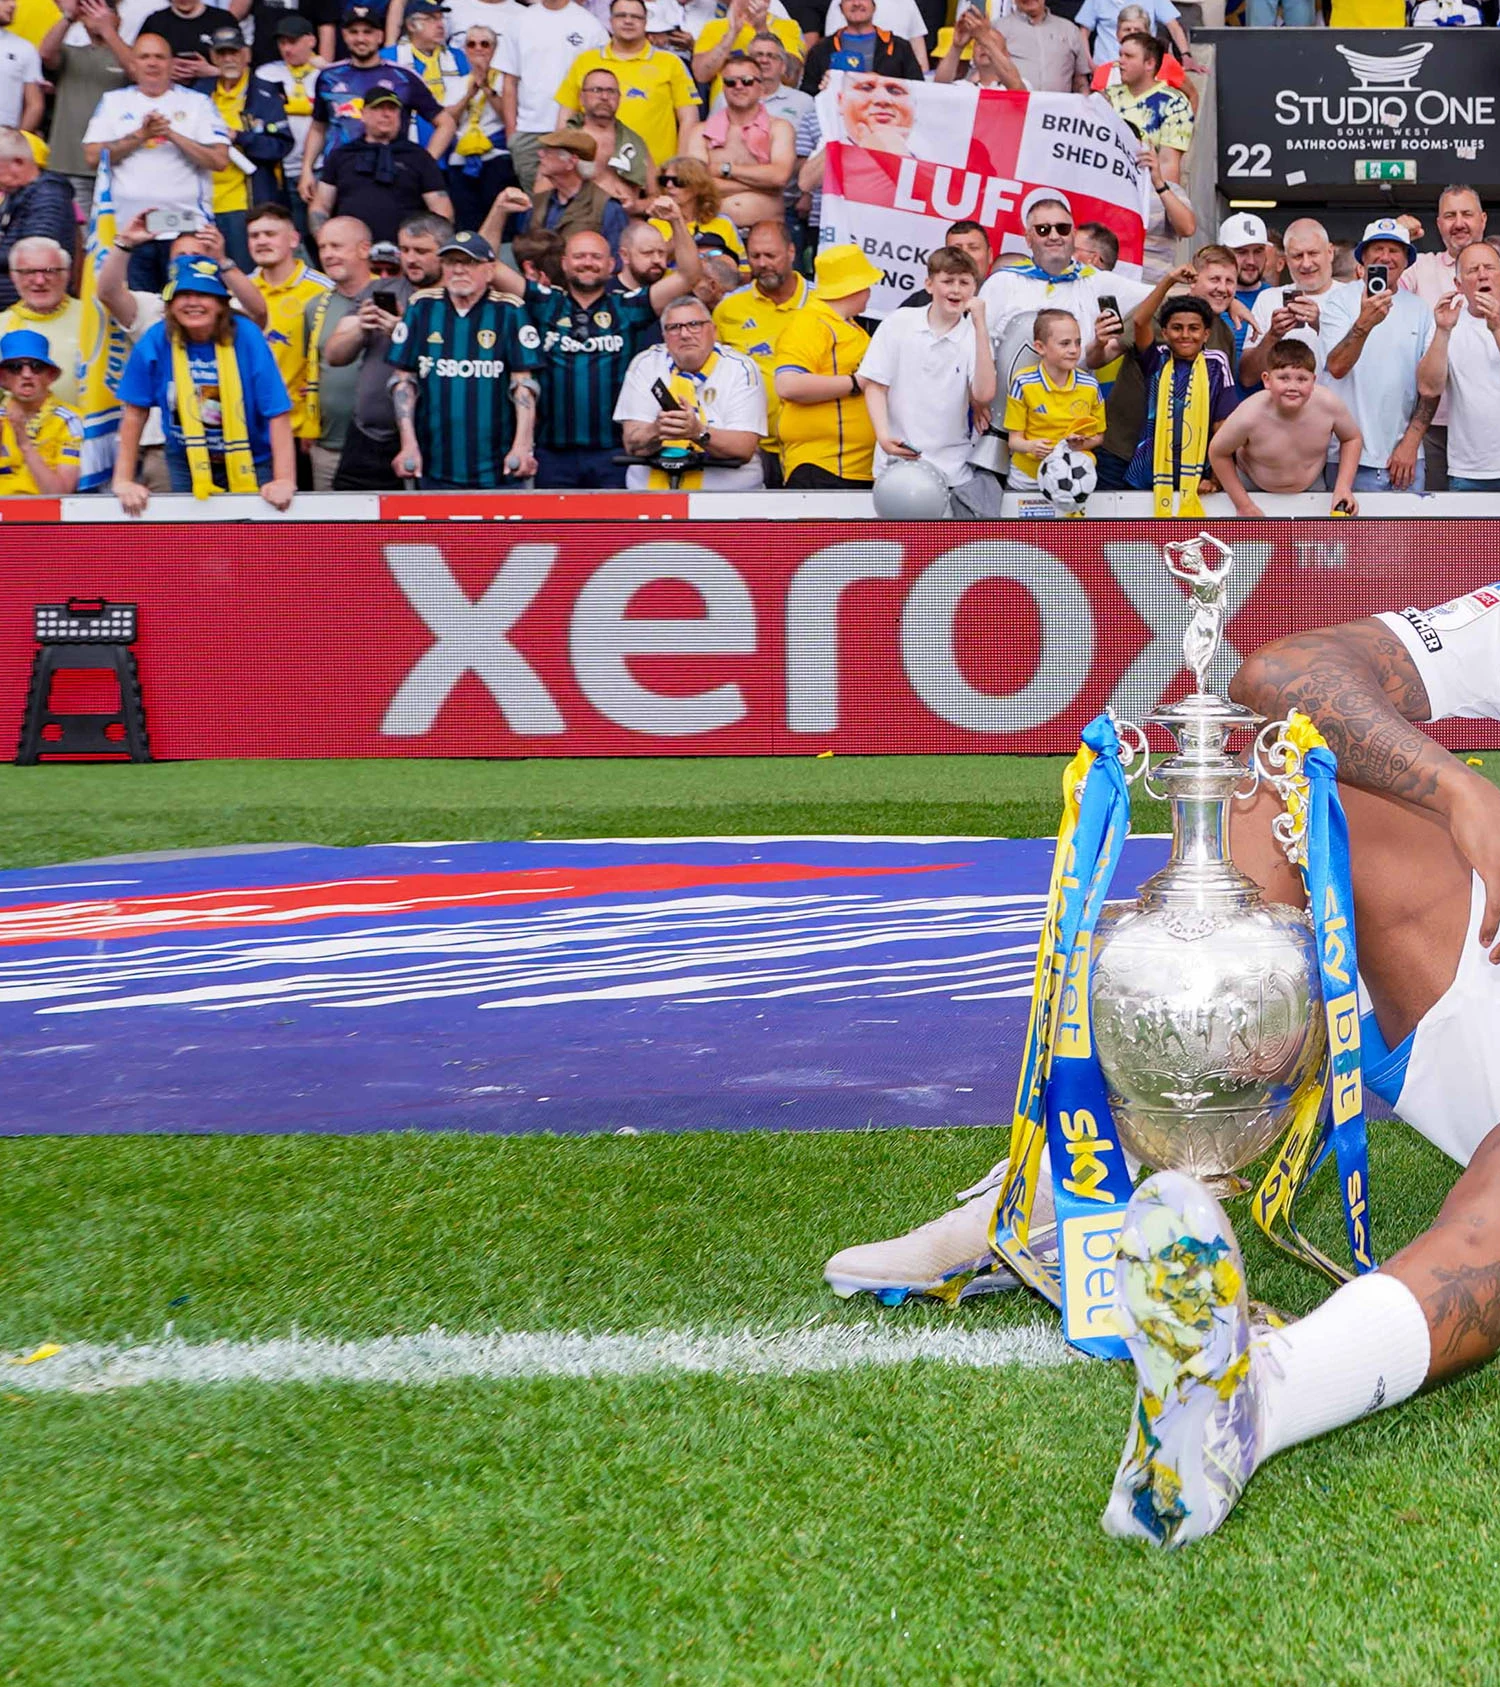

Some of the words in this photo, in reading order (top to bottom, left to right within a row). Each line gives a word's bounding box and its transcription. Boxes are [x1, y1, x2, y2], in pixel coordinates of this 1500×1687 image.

[1415, 90, 1495, 125] ONE
[1042, 114, 1112, 142] BRING
[1337, 128, 1384, 136] SOUTH
[1394, 128, 1430, 136] WEST
[1052, 142, 1109, 169] SHED
[1227, 144, 1272, 176] 22
[863, 238, 930, 265] BACK
[878, 269, 915, 290] NG
[560, 335, 624, 352] SBOTOP
[436, 359, 504, 378] SBOTOP
[380, 539, 1277, 735] xerox
[1058, 945, 1087, 1043] bet
[1059, 1108, 1116, 1204] sky
[1347, 1170, 1372, 1268] sky
